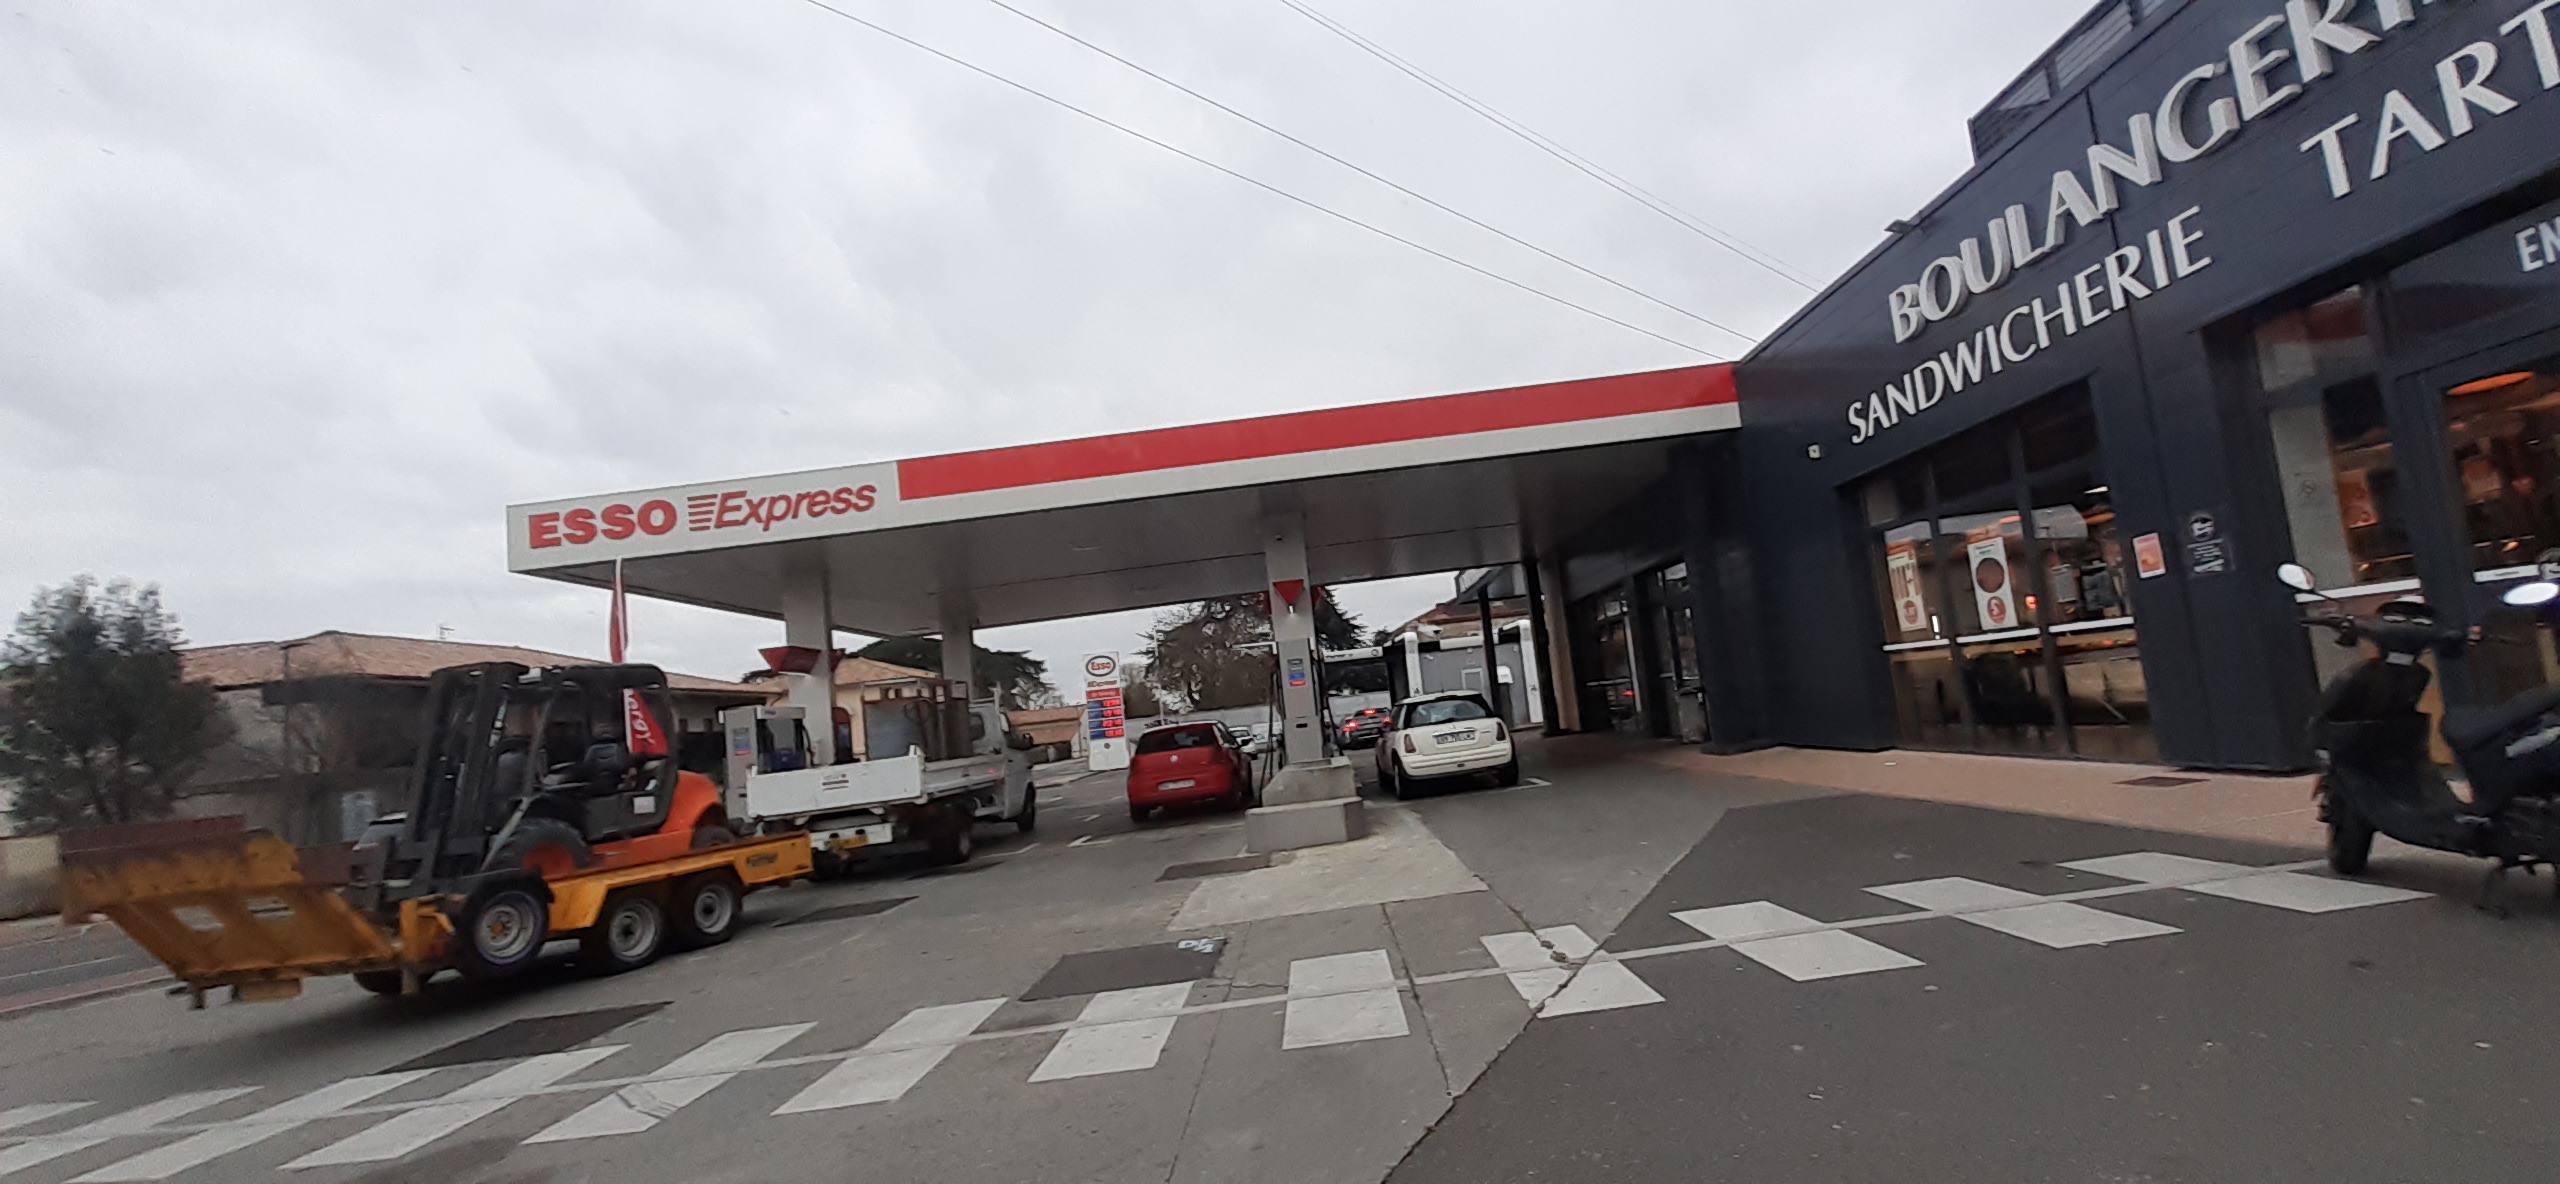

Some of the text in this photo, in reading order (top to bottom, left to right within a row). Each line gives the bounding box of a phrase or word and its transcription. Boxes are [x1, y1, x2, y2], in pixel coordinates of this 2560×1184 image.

[1888, 0, 2436, 343] BOULANGER
[1848, 204, 2213, 444] SANDWICHERIE
[528, 484, 878, 549] ESSO Express
